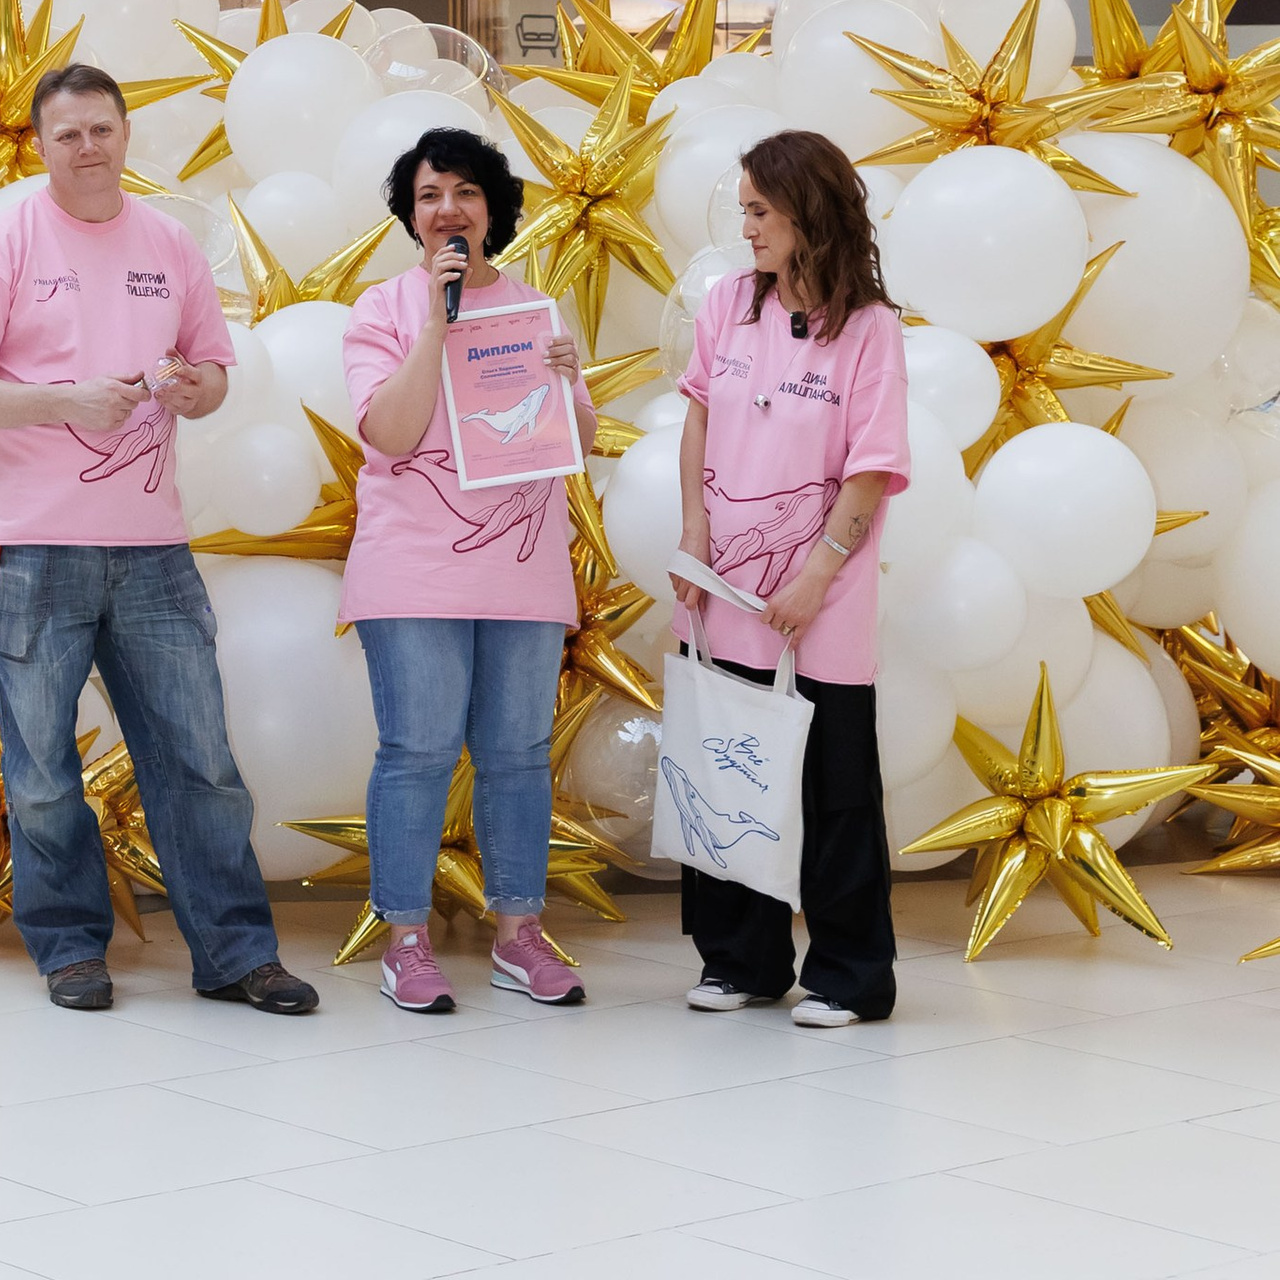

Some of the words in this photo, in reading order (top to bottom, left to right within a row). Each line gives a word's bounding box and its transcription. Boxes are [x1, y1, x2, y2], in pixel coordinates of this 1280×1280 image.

[127, 270, 166, 284] ДМИТРИЙ
[125, 284, 170, 299] ТИЩЕНКО
[467, 341, 533, 362] Диплом
[731, 367, 748, 379] 2025
[801, 371, 827, 385] ДИНА
